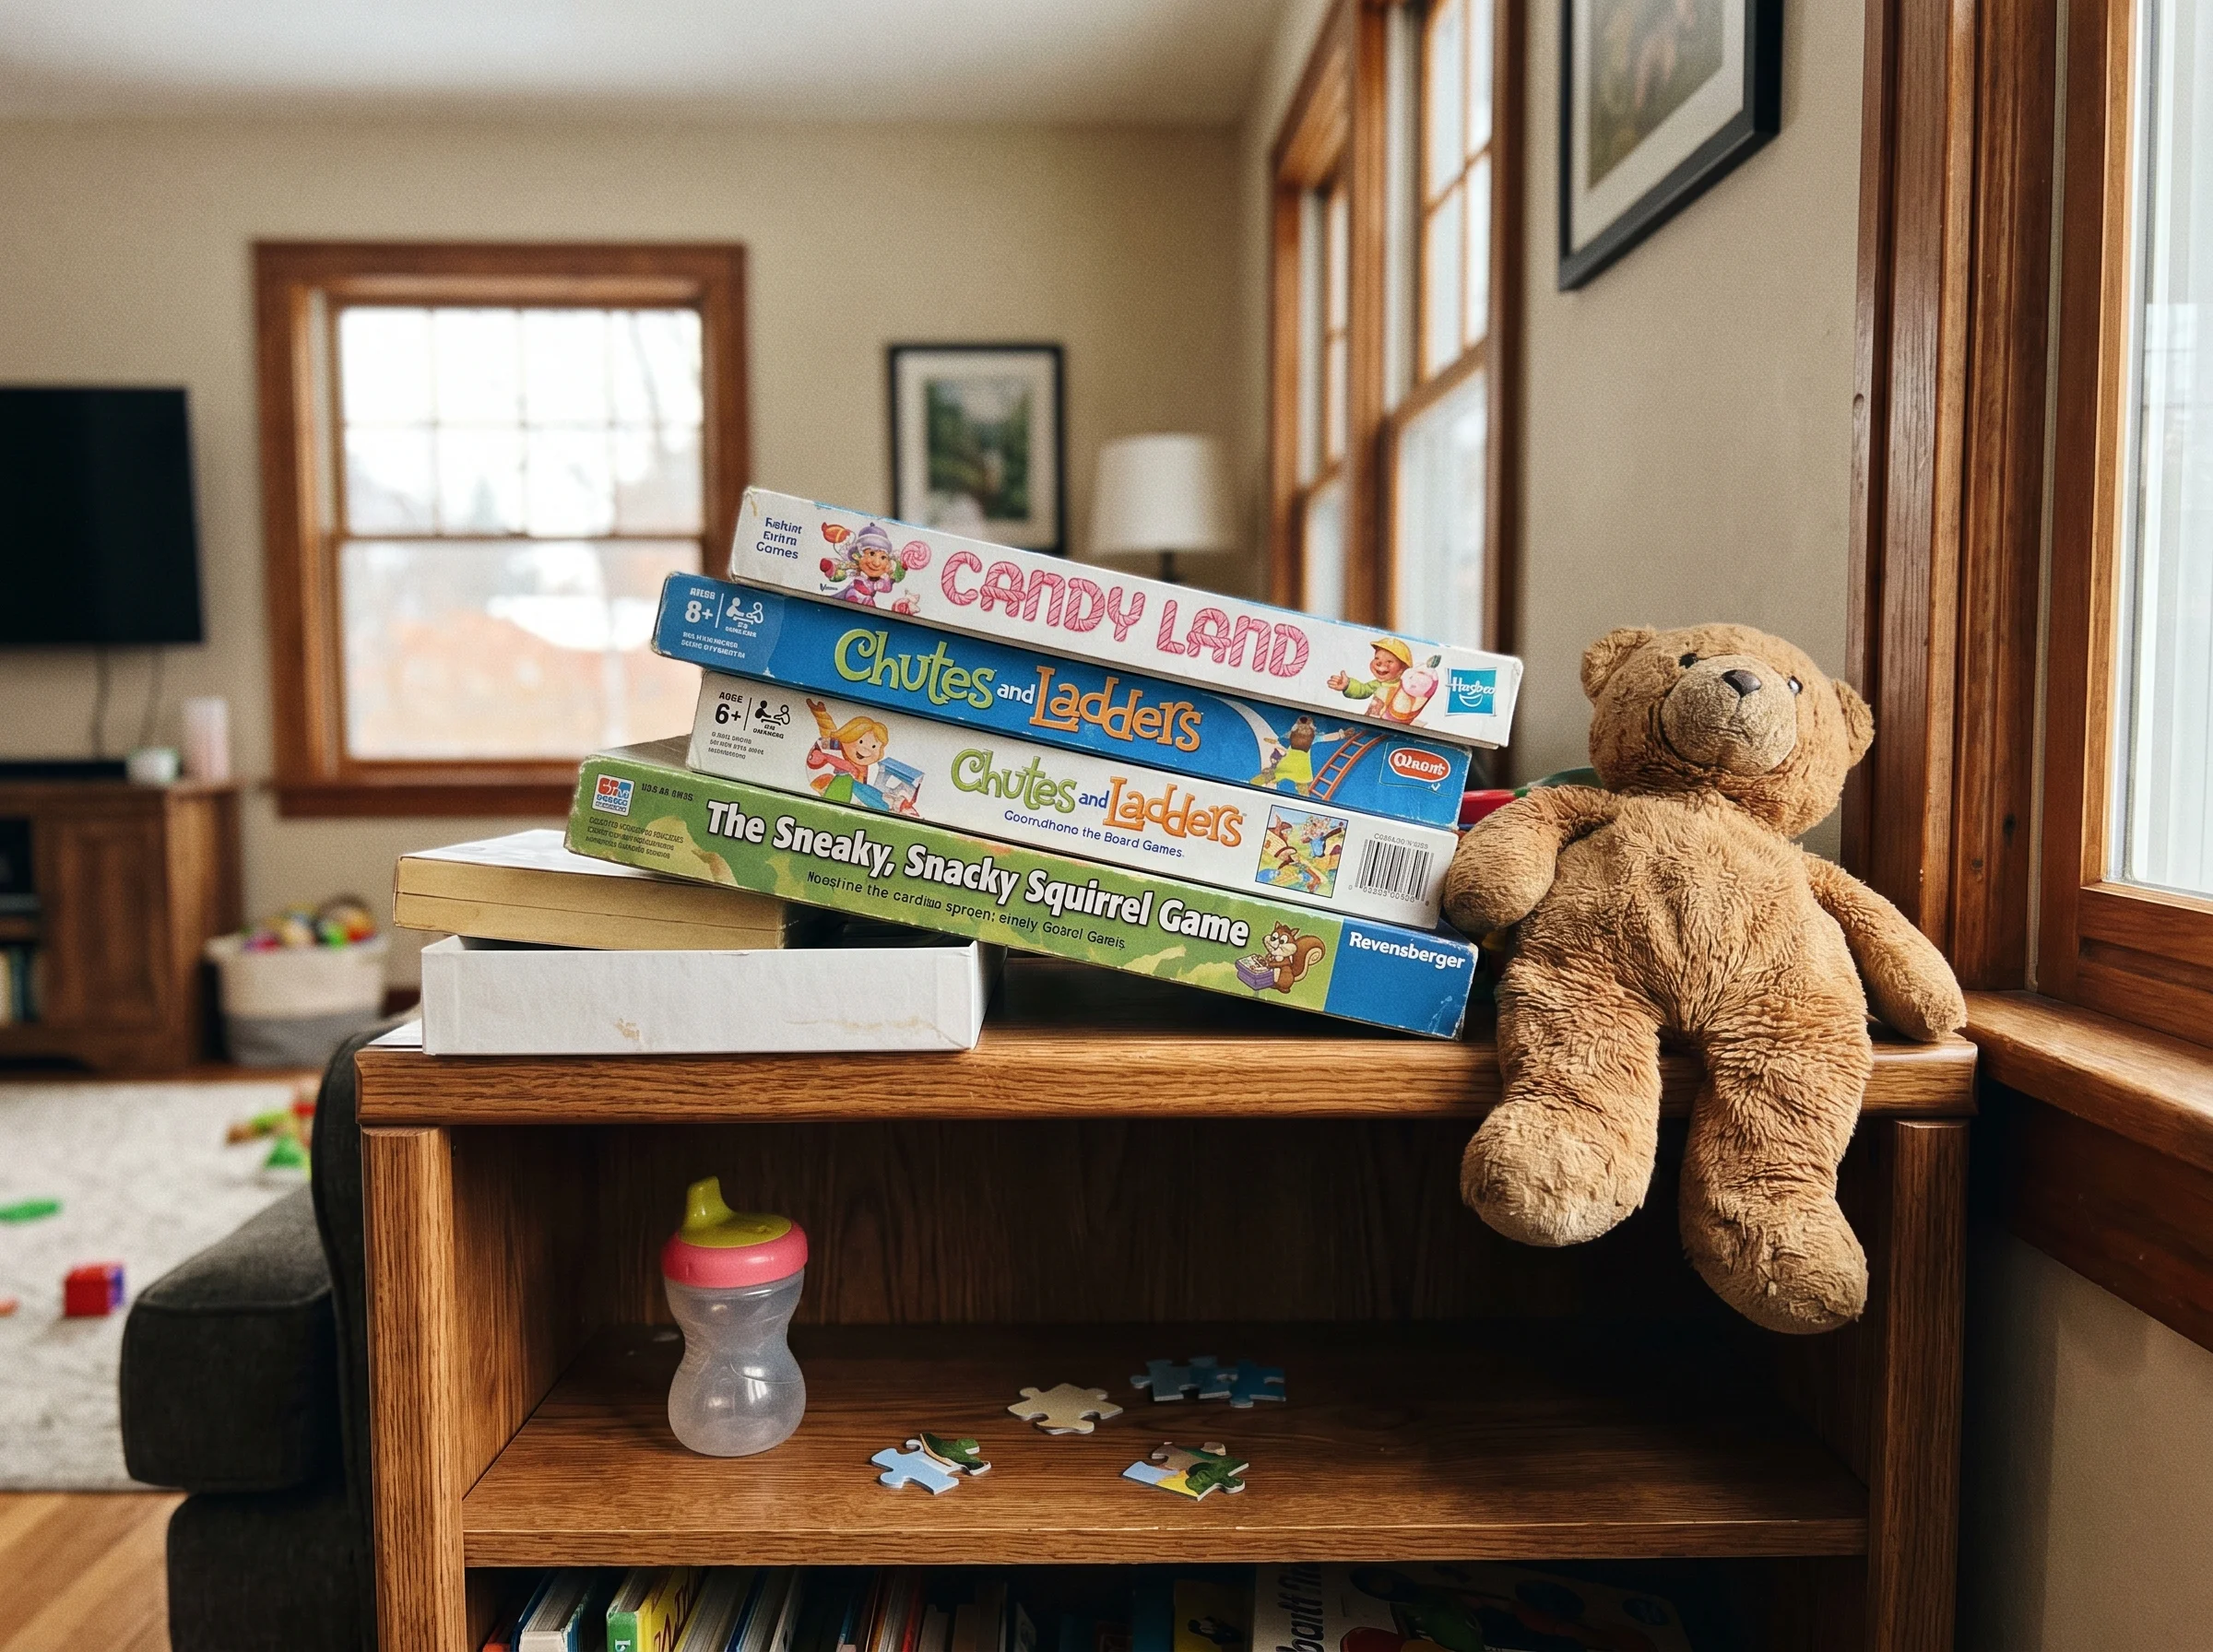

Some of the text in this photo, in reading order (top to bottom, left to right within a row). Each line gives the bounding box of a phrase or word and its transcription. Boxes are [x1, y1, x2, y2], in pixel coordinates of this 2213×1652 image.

[684, 600, 714, 623] 8+
[941, 550, 1309, 678] CANDY LAND
[834, 628, 1201, 752] Chutes and Ladders
[715, 703, 741, 725] 6+
[951, 748, 1244, 847] Chutes and Ladders
[1082, 826, 1102, 842] the
[1104, 832, 1140, 849] Board
[706, 799, 766, 844] The
[772, 815, 896, 878] Sneaky,
[903, 844, 1020, 905] Snacky
[1024, 868, 1154, 926] Squirrel
[1158, 898, 1250, 947] Game
[867, 885, 889, 900] the
[1349, 931, 1466, 969] Revensberger
